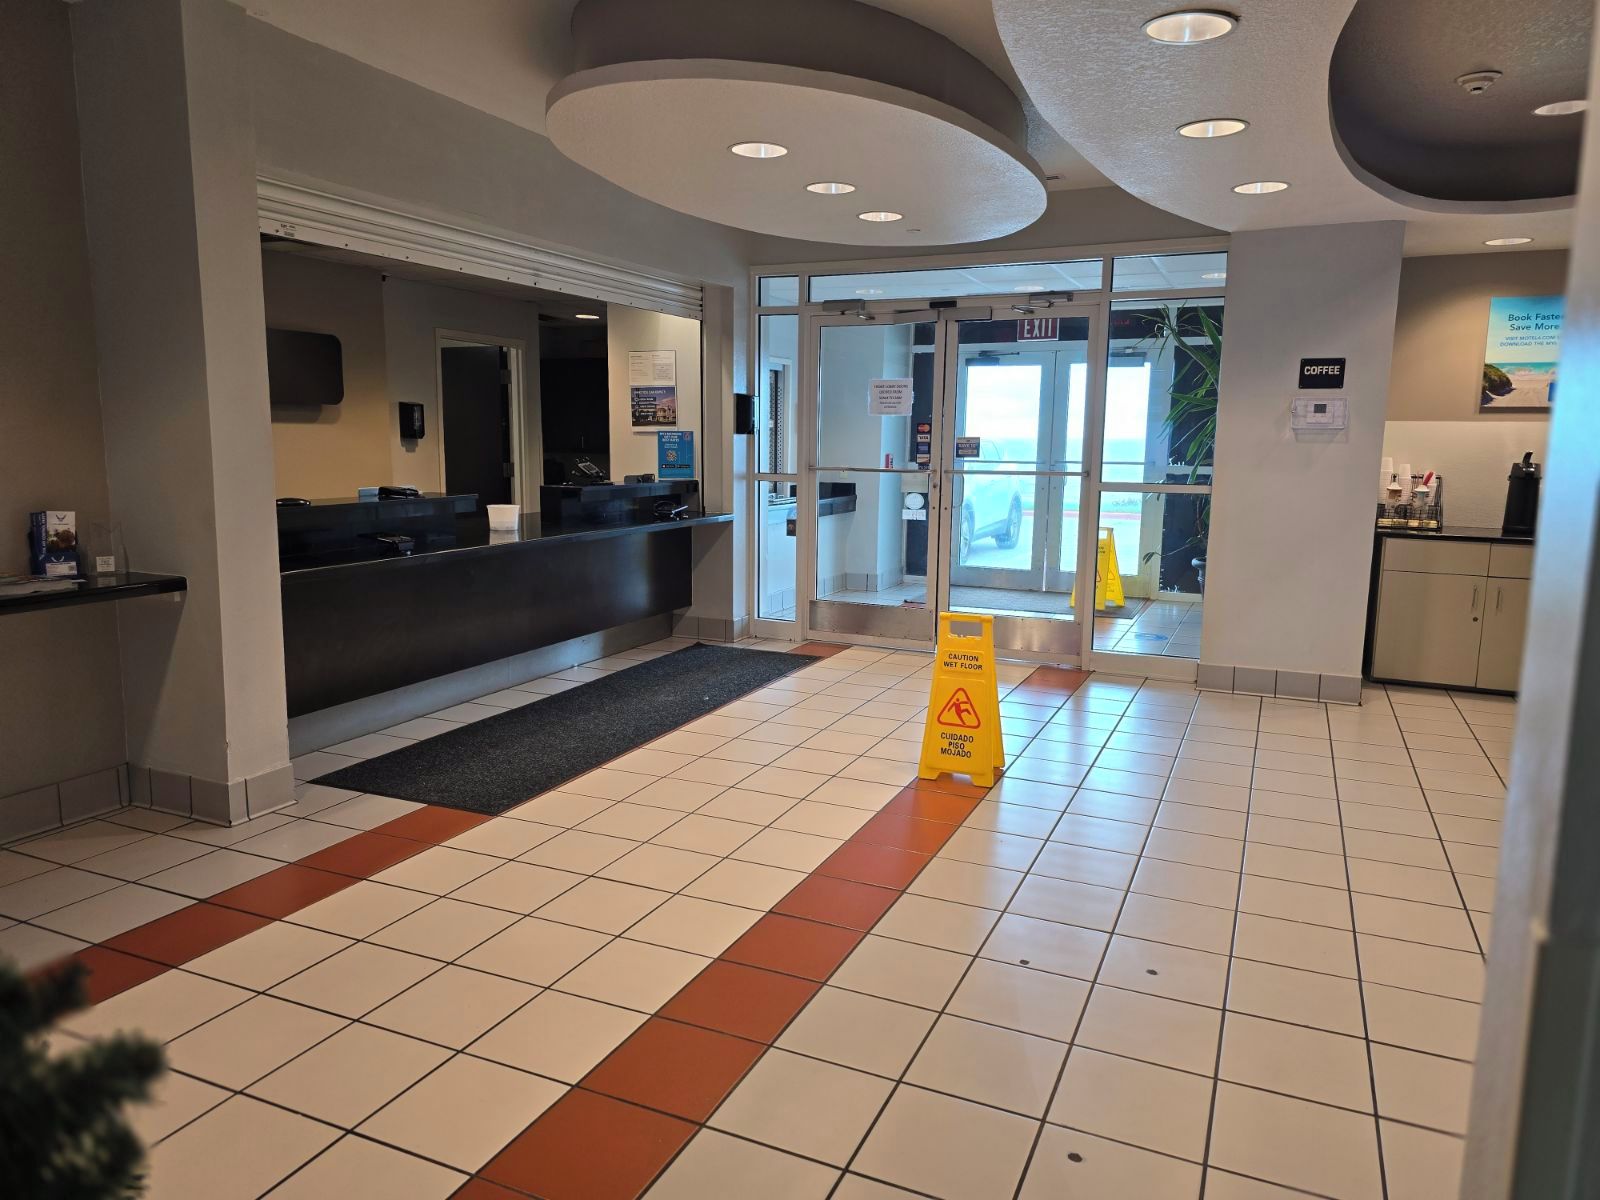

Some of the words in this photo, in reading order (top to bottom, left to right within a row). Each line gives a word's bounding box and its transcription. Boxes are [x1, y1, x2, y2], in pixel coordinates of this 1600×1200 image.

[1508, 313, 1532, 321] Book
[1023, 318, 1053, 337] EXIT
[1509, 323, 1532, 331] Save
[1304, 365, 1341, 375] COFFEE
[948, 653, 979, 662] CAUTION
[960, 662, 983, 671] FLOOR
[940, 732, 974, 743] CUIDADO
[948, 741, 965, 750] PISO
[940, 747, 972, 759] MOJADO
